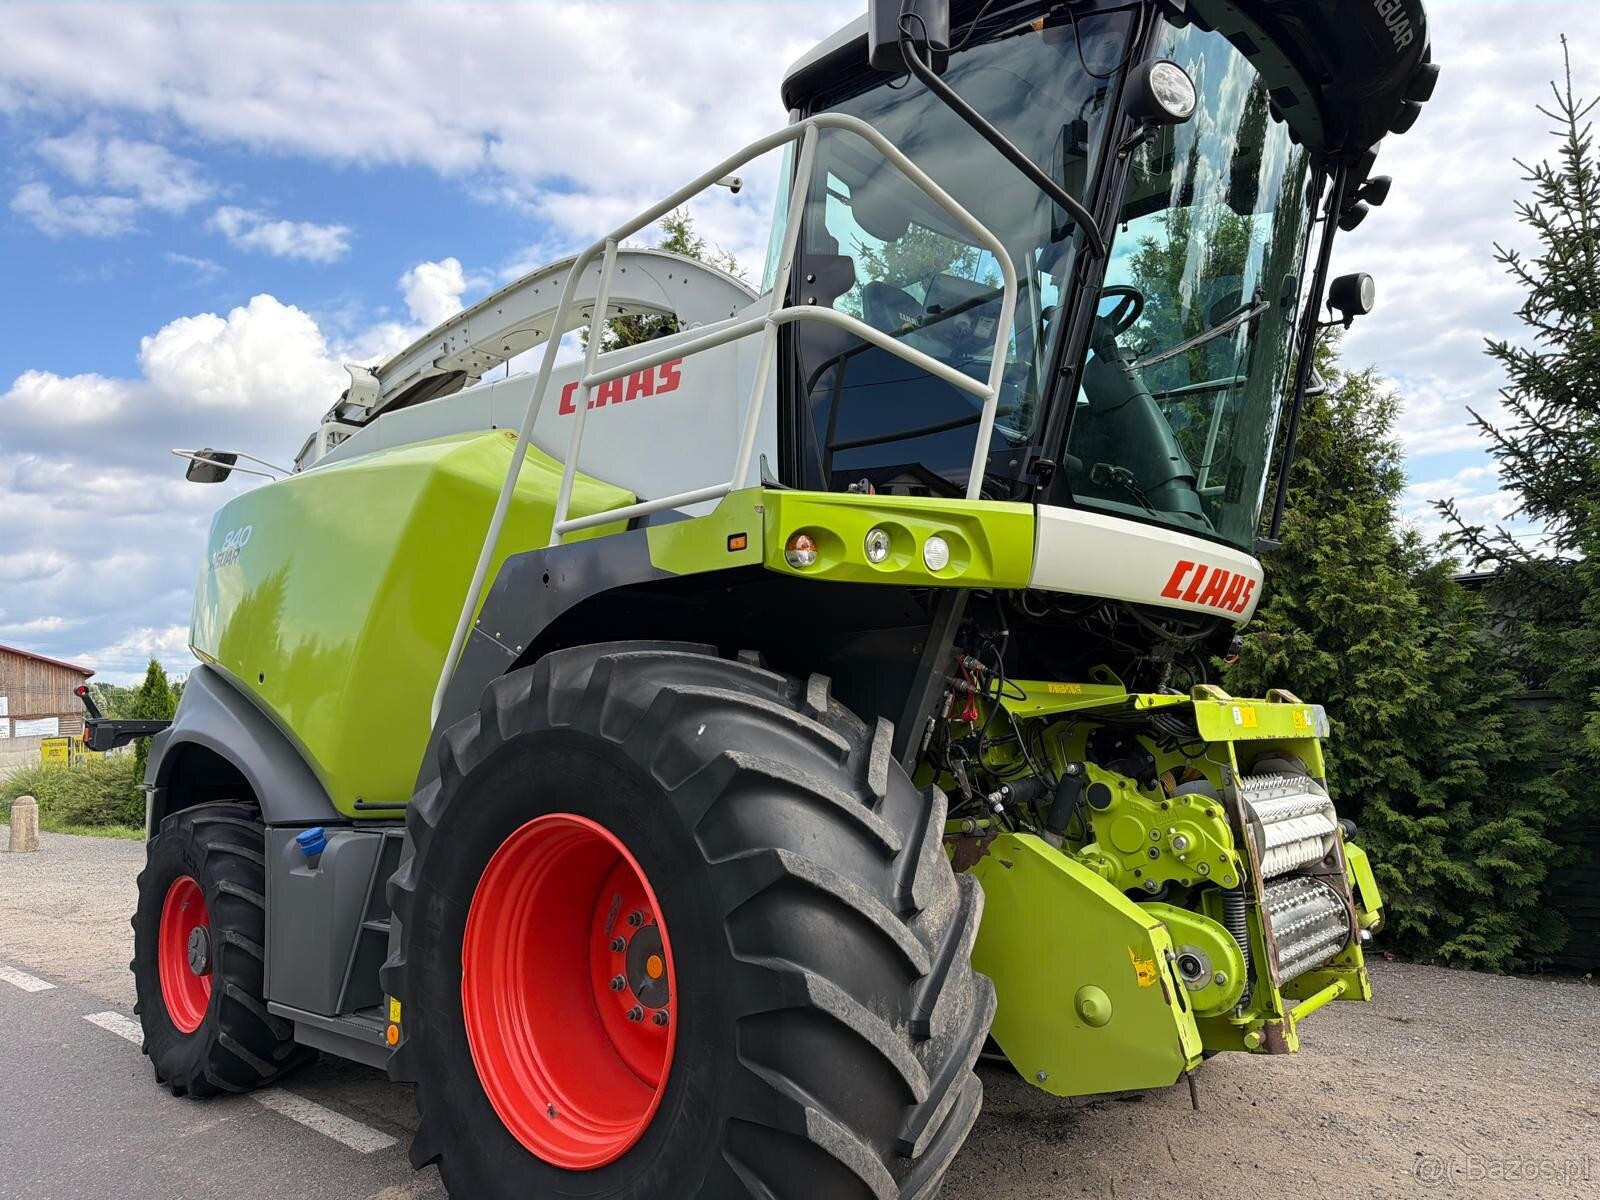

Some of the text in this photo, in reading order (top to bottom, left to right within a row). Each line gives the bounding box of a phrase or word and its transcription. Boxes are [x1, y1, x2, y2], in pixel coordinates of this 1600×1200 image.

[1373, 0, 1414, 53] GUAR
[558, 357, 684, 416] CAAS
[1160, 559, 1256, 614] CLAAS
